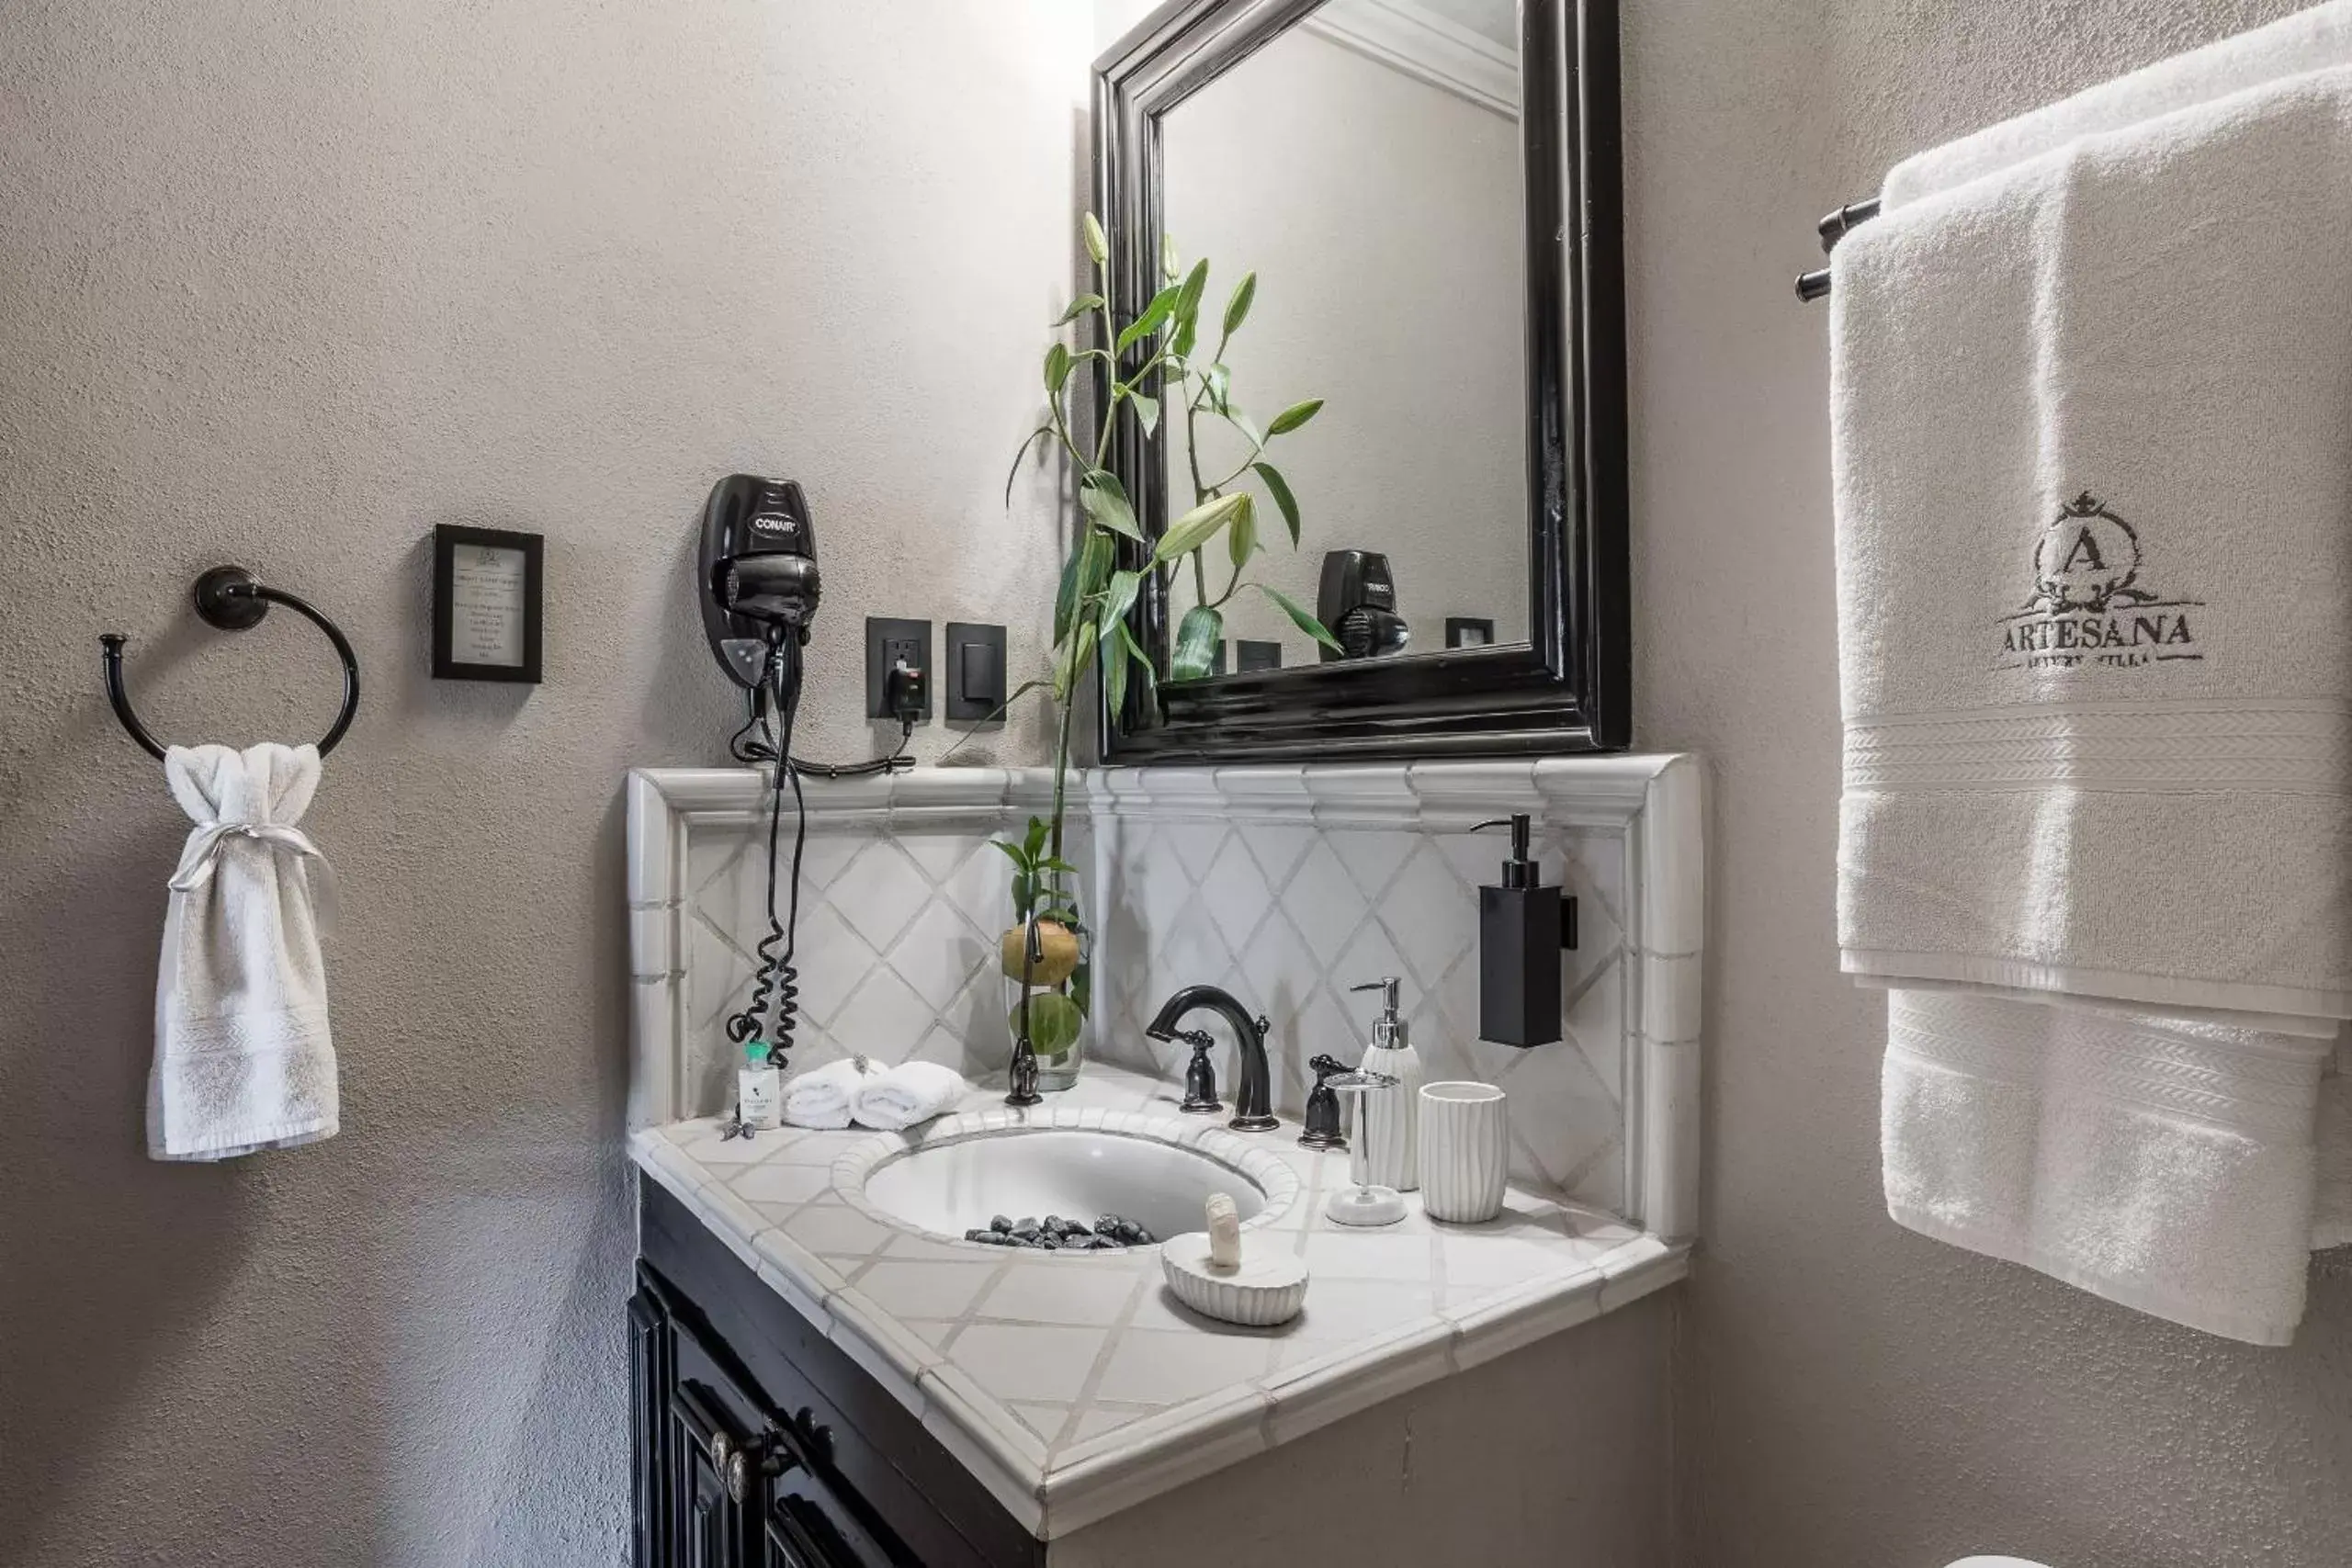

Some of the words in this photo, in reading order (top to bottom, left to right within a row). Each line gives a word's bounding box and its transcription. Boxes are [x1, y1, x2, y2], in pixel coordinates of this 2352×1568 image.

[754, 519, 796, 533] CONAIR
[2063, 526, 2106, 572] A
[2004, 615, 2193, 652] ARTESANA
